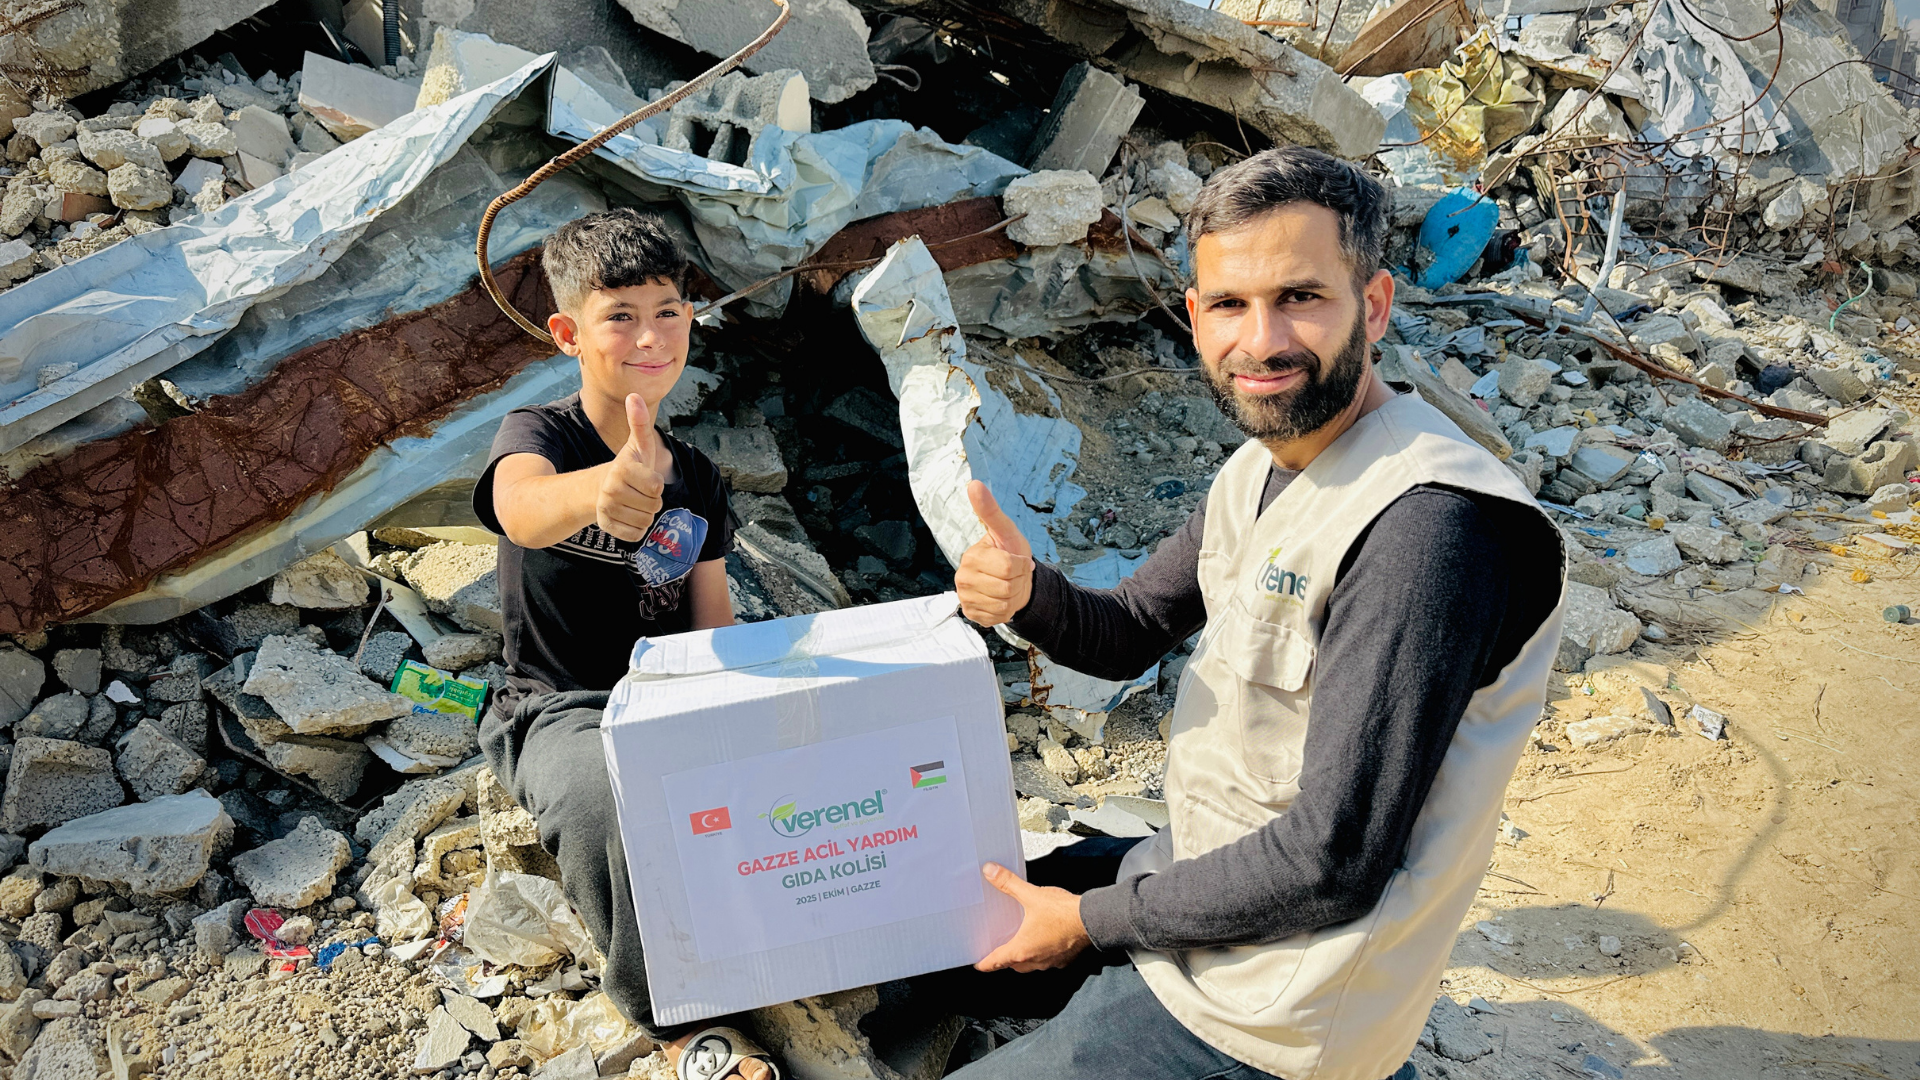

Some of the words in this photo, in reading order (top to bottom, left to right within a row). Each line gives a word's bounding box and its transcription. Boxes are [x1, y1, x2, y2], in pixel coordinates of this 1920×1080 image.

[780, 789, 884, 833] verenel
[737, 850, 800, 876] GAZZE
[803, 839, 844, 863] ACİL
[846, 825, 918, 853] YARDIM
[782, 869, 827, 889] GIDA
[830, 850, 887, 880] KOLİSİ
[796, 894, 817, 905] 2025
[822, 887, 845, 899] EKİM
[850, 880, 881, 893] GAZZE
